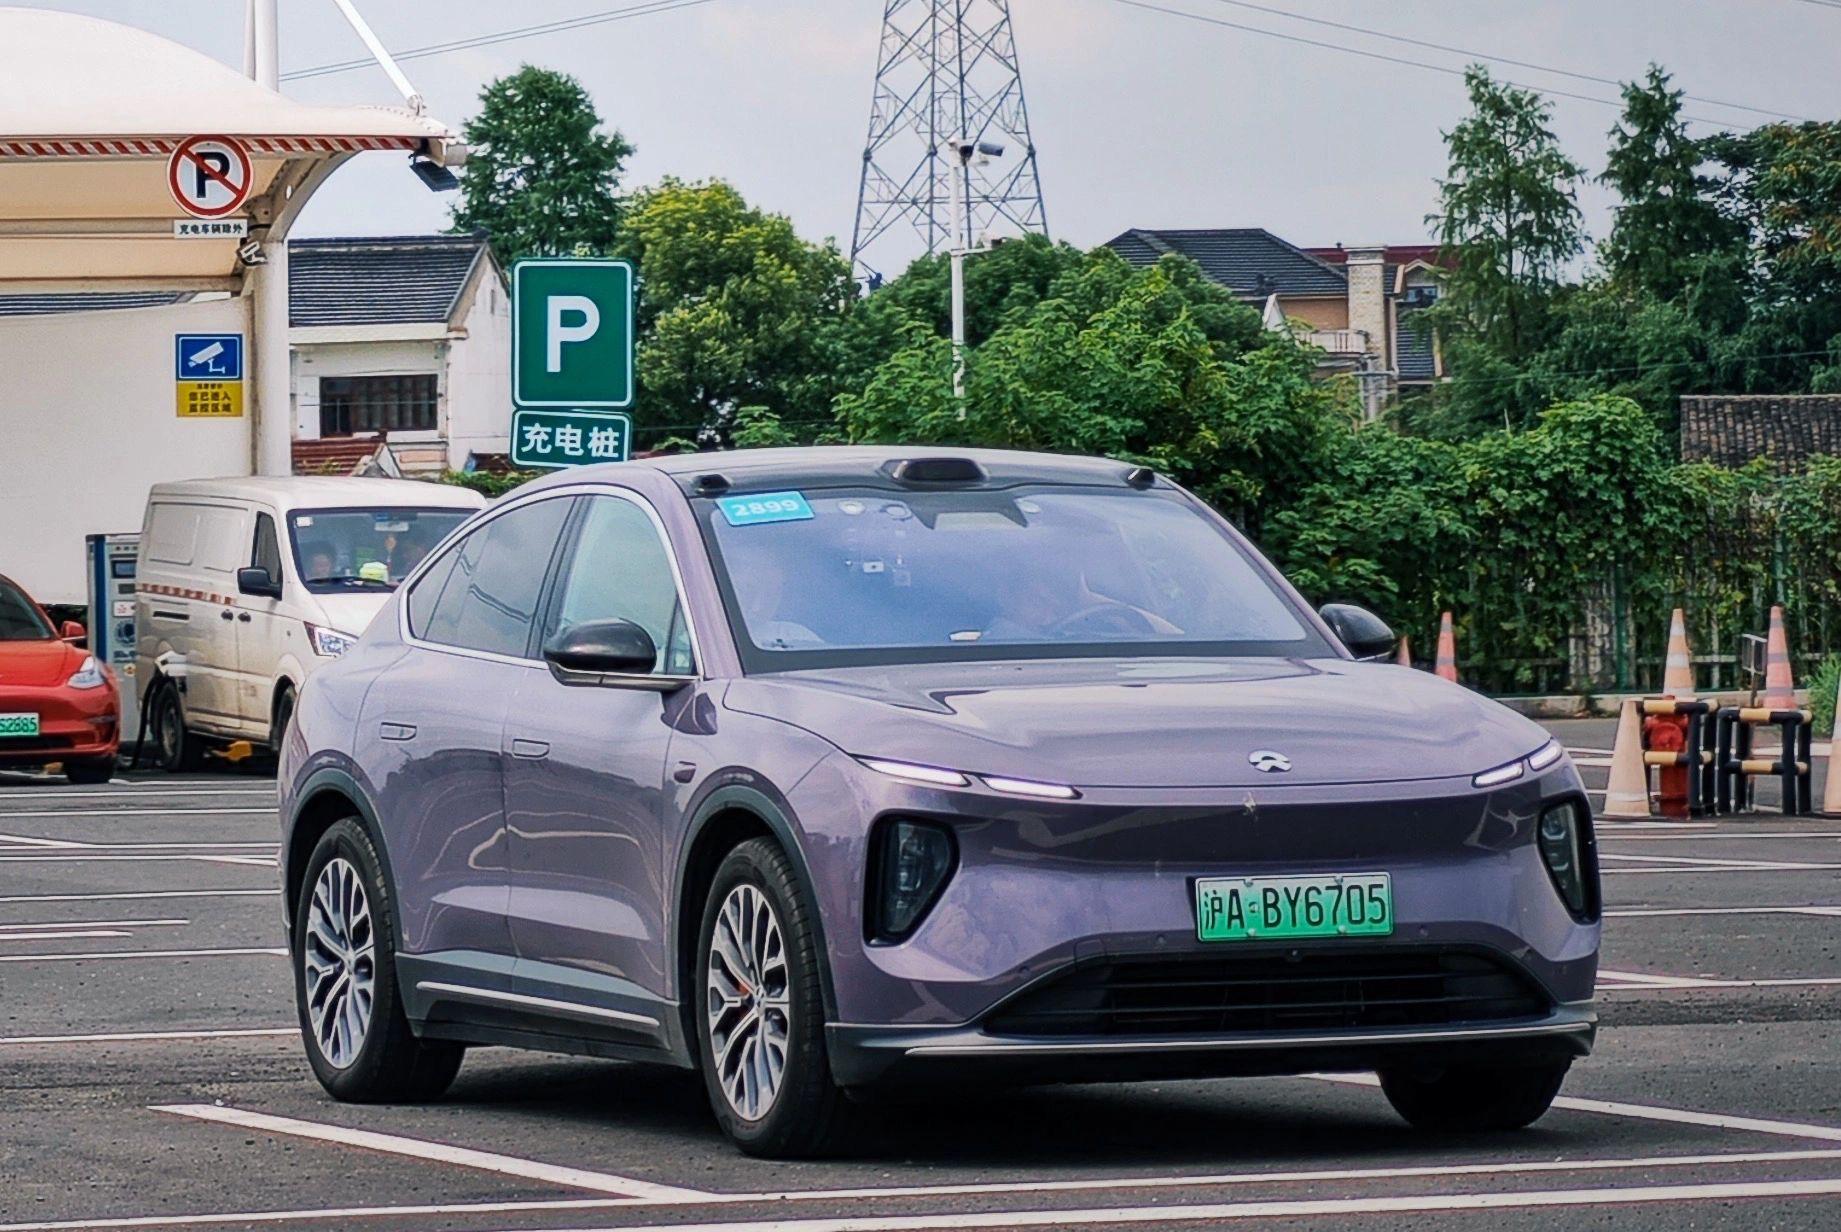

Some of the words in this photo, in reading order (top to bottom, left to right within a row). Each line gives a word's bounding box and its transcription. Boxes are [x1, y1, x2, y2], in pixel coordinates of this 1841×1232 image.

[196, 151, 230, 198] P
[547, 295, 600, 372] P
[521, 422, 620, 458] 充电桩
[732, 499, 800, 516] 2899
